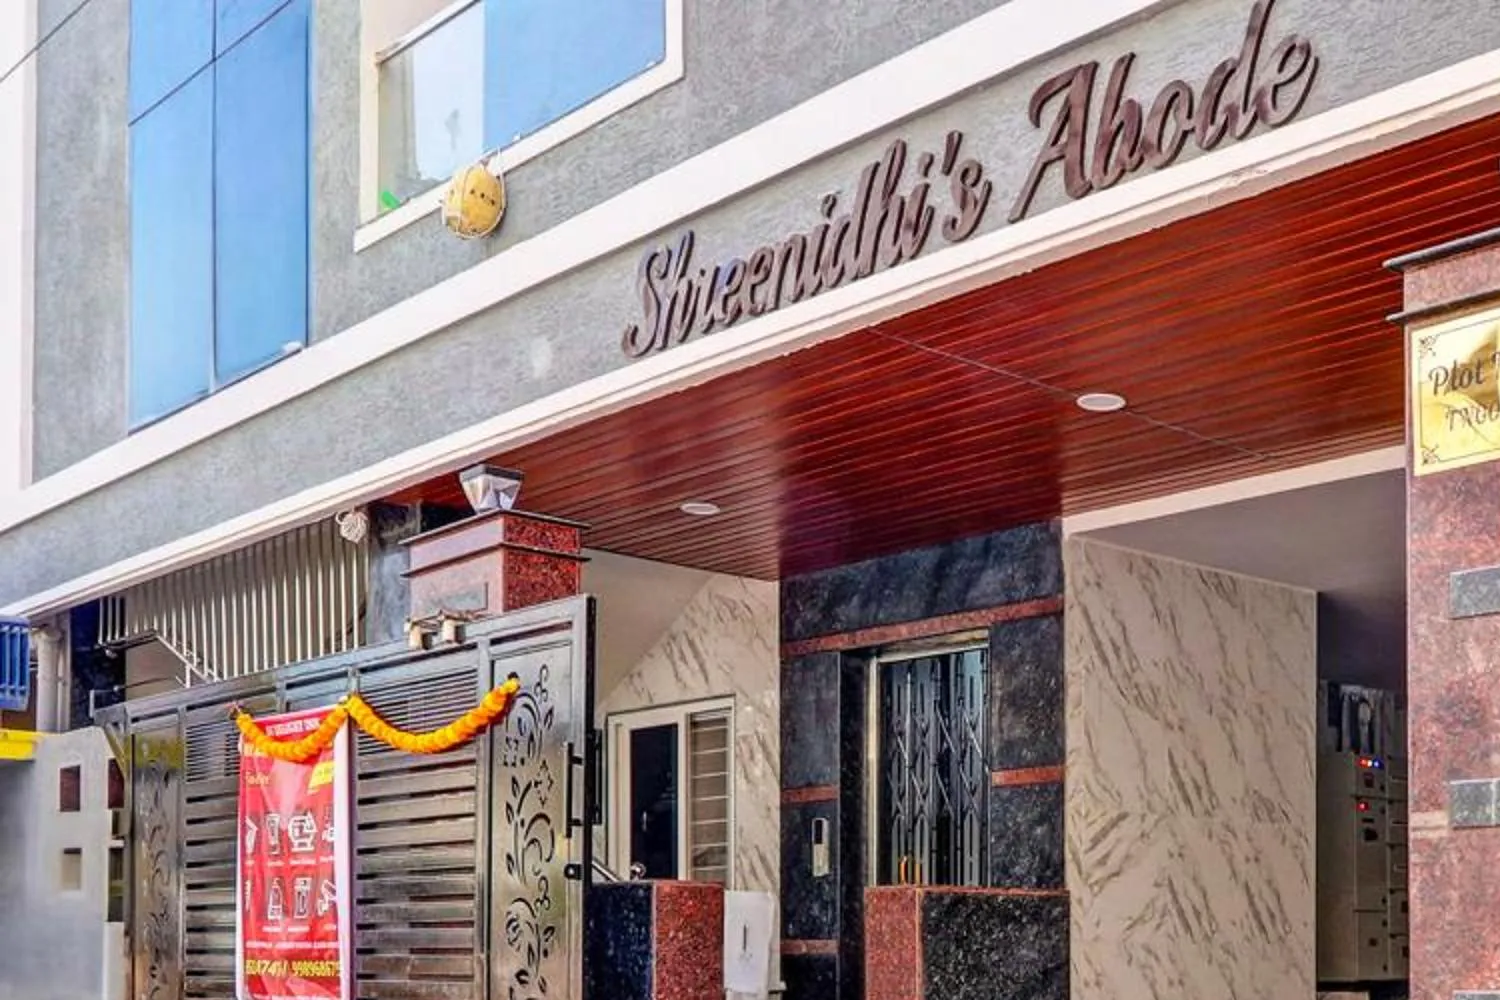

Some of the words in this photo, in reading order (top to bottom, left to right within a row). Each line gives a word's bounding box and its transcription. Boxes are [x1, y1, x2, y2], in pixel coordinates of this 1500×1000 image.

[622, 130, 992, 358] Shreenidhi's
[1007, 0, 1319, 223] Abode
[1428, 358, 1485, 396] Plot
